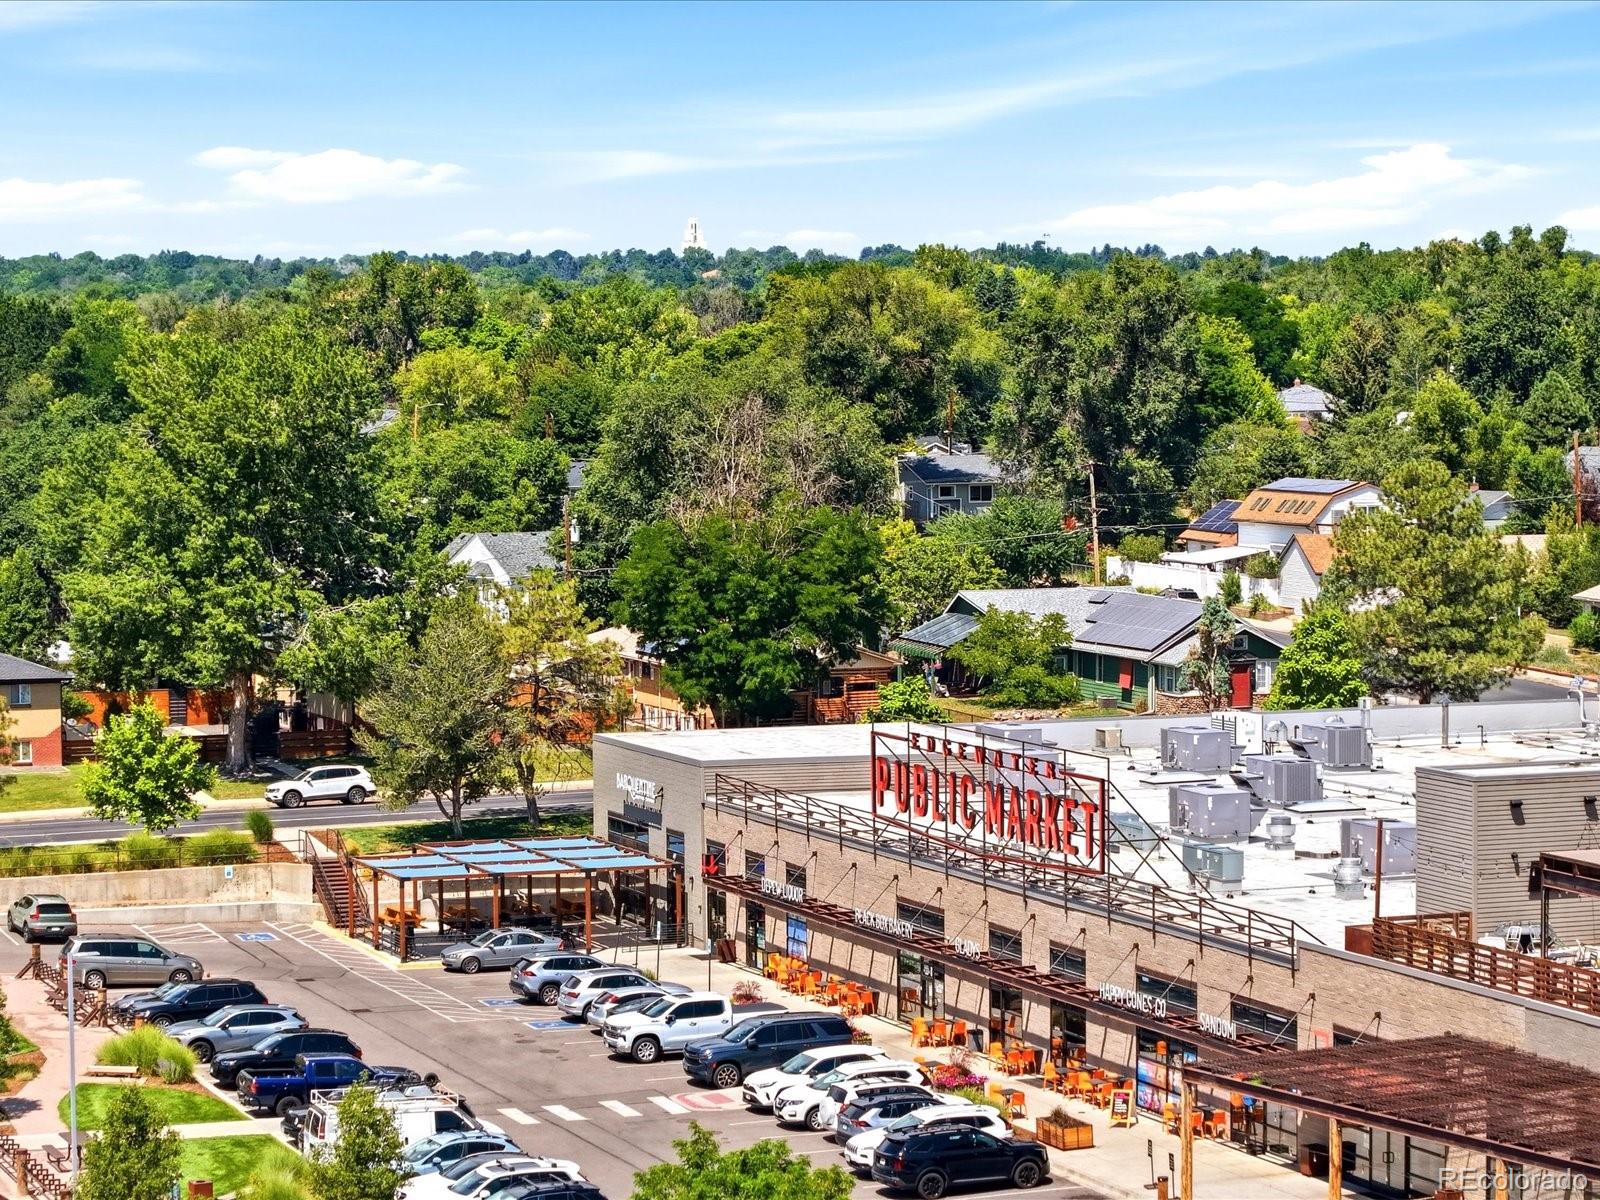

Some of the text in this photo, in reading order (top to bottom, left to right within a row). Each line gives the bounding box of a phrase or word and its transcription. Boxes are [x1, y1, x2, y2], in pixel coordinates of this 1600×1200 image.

[911, 732, 1057, 779] EDGEWATER
[875, 756, 1098, 859] PUBLIC MARKET
[1099, 981, 1126, 1004] HAPPY
[1126, 990, 1153, 1014] CONES
[1199, 1012, 1237, 1041] SANDOMI
